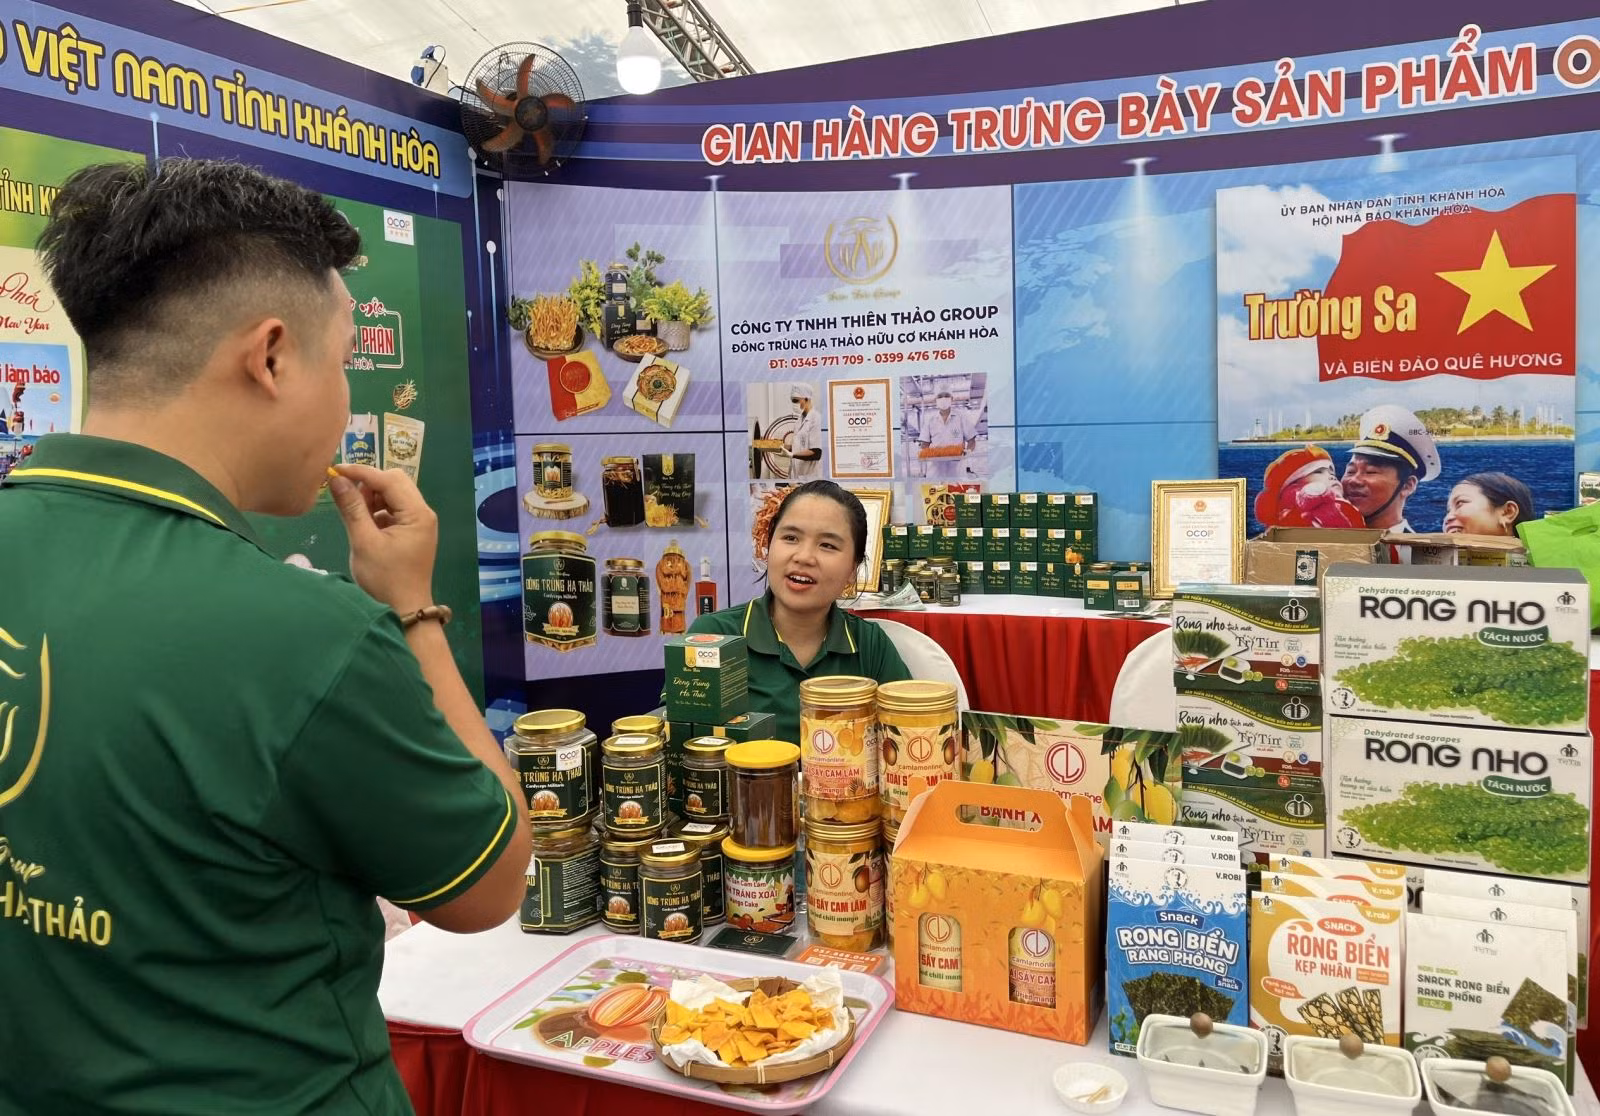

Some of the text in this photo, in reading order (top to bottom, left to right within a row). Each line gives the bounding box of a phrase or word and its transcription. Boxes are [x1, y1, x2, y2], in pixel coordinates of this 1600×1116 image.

[16, 23, 440, 178] VIỆT NAM TỈNH KHÁNH HÒA
[703, 124, 801, 166] GIAN
[813, 105, 937, 161] HÀNG
[948, 97, 1103, 153] TRƯNG
[1118, 76, 1221, 137] BÀY
[1233, 57, 1344, 126] SẢN
[1363, 24, 1536, 112] PHẨM
[1300, 205, 1325, 215] BAN
[1429, 190, 1474, 202] KHÁNH
[731, 305, 999, 336] CÔNG TY TNHH THIÊN THẢO GROUP
[1244, 285, 1417, 341] Trường Sa
[769, 337, 807, 352] TRÙNG
[811, 339, 828, 351] HẠ
[831, 332, 864, 349] THẢO
[868, 331, 894, 346] HỮU
[897, 331, 916, 343] CƠ
[919, 328, 966, 342] KHÁNH
[969, 326, 999, 339] HÒA
[769, 349, 956, 369] ĐT: 0345 771 709 0399 476 768
[1324, 358, 1348, 375] VÀ
[1444, 352, 1484, 371] QUÊ
[1490, 352, 1563, 369] HƯƠNG
[5, 363, 60, 384] làm báo
[1358, 586, 1457, 599] Dehydrated seagrapes
[1360, 595, 1545, 625] RONG NHO
[1176, 615, 1202, 634] Rong
[1206, 617, 1225, 631] nho
[1482, 630, 1545, 643] TÁCH NƯỚC
[1178, 710, 1205, 728] Rong
[1208, 712, 1228, 726] nho
[1364, 728, 1461, 744] Dehydrated seagrapes
[1365, 738, 1549, 776] RONG NHO
[524, 770, 550, 783] TRÙNG
[825, 768, 842, 778] CAM
[1487, 778, 1548, 793] TÁCH NƯỚC
[1181, 805, 1208, 824] Rong
[1212, 807, 1231, 821] nho
[1210, 834, 1234, 842] V.ROBI
[1211, 852, 1236, 861] V.ROBI
[1215, 872, 1241, 881] V.ROBI
[831, 901, 849, 912] CAM
[851, 900, 867, 912] LÂM
[28, 896, 111, 946] THẢO
[1160, 911, 1199, 926] Snack
[1324, 920, 1358, 933] SNACK
[1118, 927, 1238, 962] RONG BIỂN
[1287, 932, 1390, 968] RONG BIỂN
[938, 957, 959, 970] CAM
[1128, 949, 1170, 962] RANG
[1295, 959, 1317, 976] KẸP
[1320, 962, 1352, 979] NHÂN
[1217, 980, 1239, 990] Snack
[1417, 974, 1451, 987] SNACK
[1455, 979, 1483, 992] RONG
[1417, 987, 1444, 998] RANG
[546, 1030, 657, 1064] APPLES
